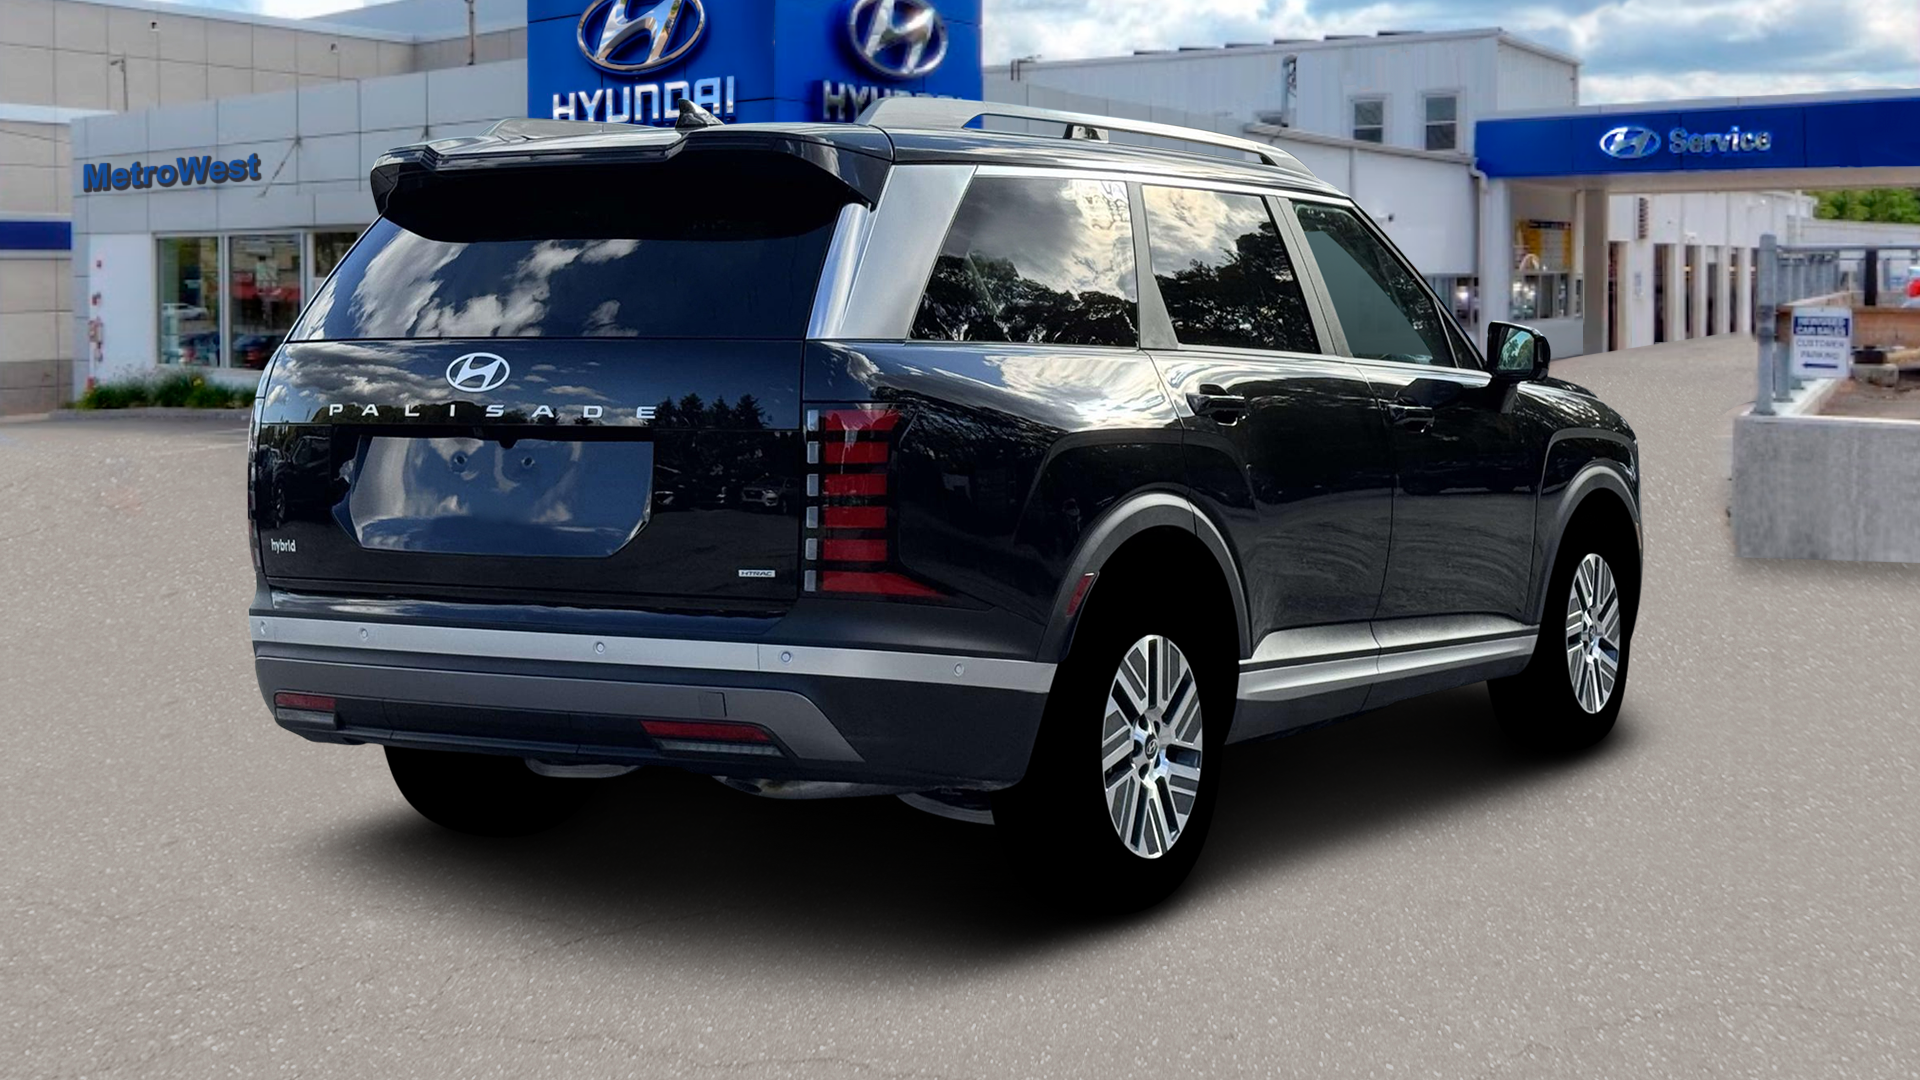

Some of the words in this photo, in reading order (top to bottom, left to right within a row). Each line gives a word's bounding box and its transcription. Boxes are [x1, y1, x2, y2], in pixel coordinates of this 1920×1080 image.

[552, 75, 736, 123] HYUNDAI
[1669, 126, 1771, 153] Service
[83, 153, 261, 192] MetroWest
[329, 403, 657, 419] PALISADE
[270, 538, 297, 554] hybrid
